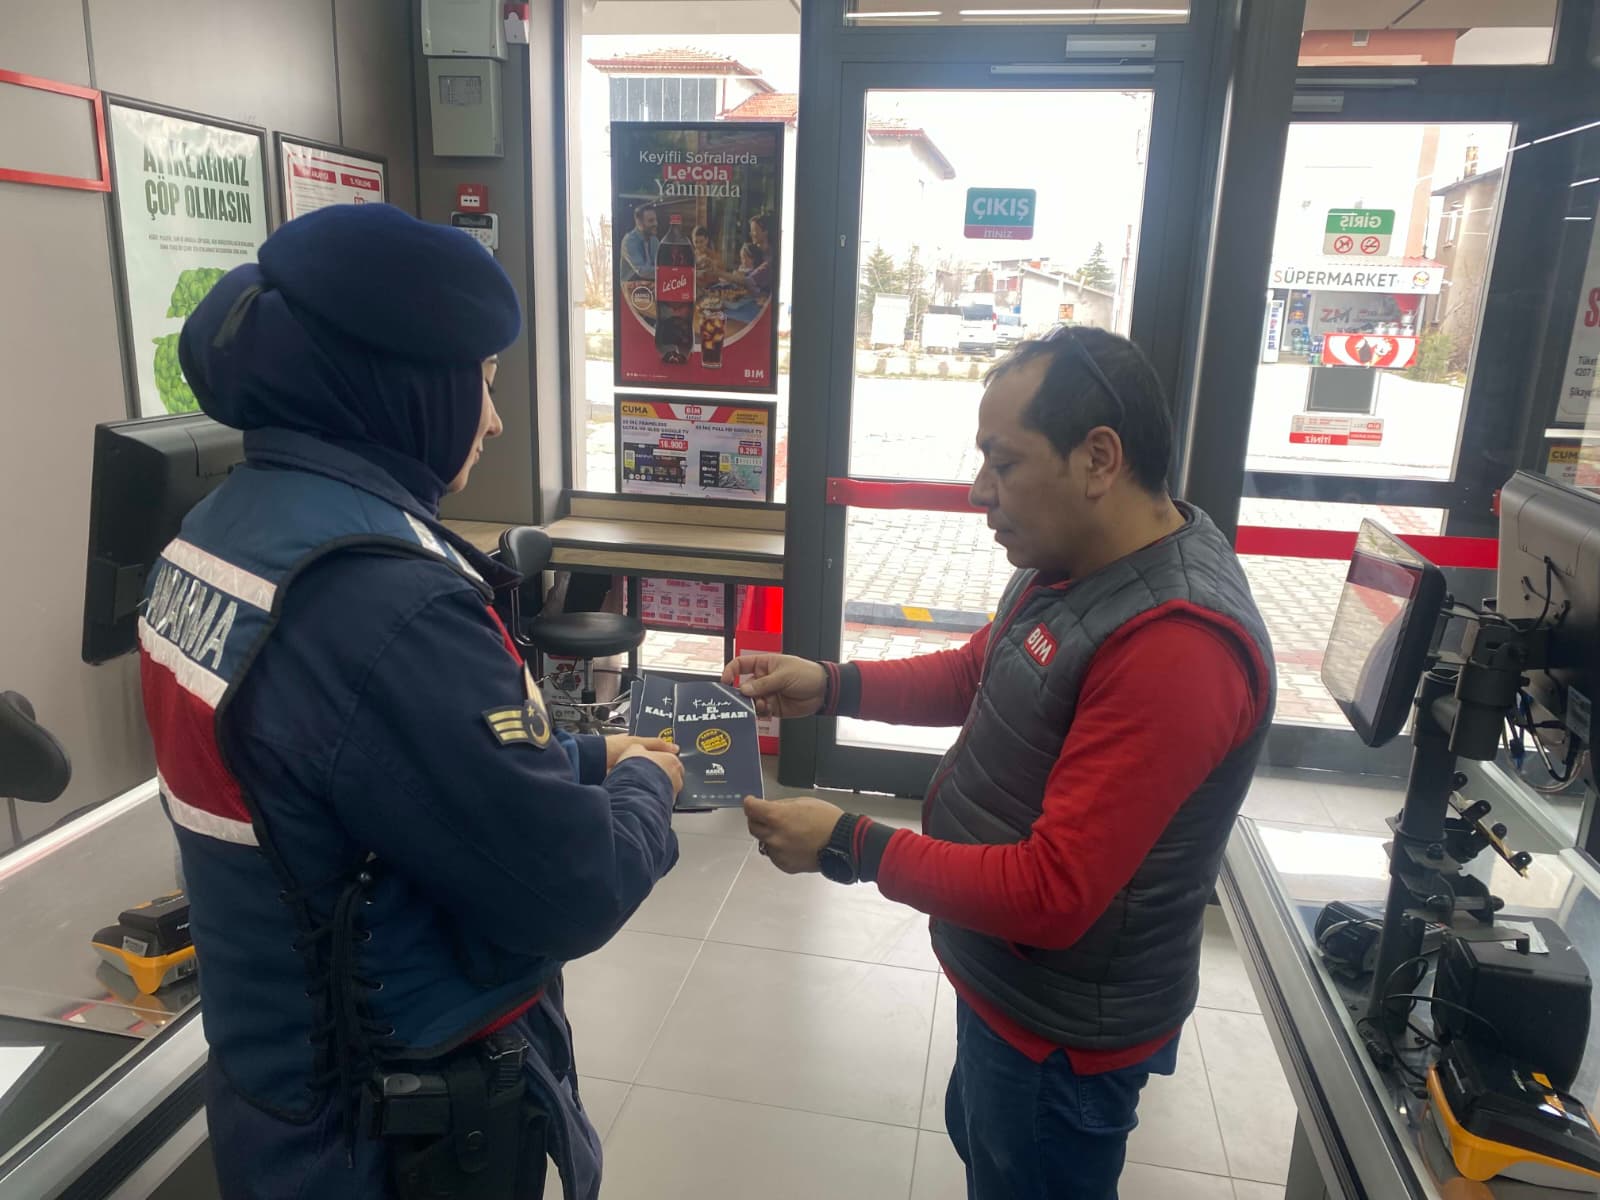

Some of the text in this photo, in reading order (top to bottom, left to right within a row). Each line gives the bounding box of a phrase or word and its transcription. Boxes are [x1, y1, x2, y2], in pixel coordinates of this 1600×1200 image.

[639, 150, 758, 165] Keyifli Sofralarda
[667, 166, 728, 181] Le'Cola
[144, 175, 180, 221] ÇÖP
[184, 184, 252, 224] OLMASIN
[972, 196, 1030, 222] ÇIKIŞ
[1274, 266, 1398, 287] SÜPERMARKET
[1584, 286, 1600, 328] S
[622, 404, 648, 414] CUMA
[1551, 450, 1579, 460] CUM
[1026, 627, 1053, 663] BIM
